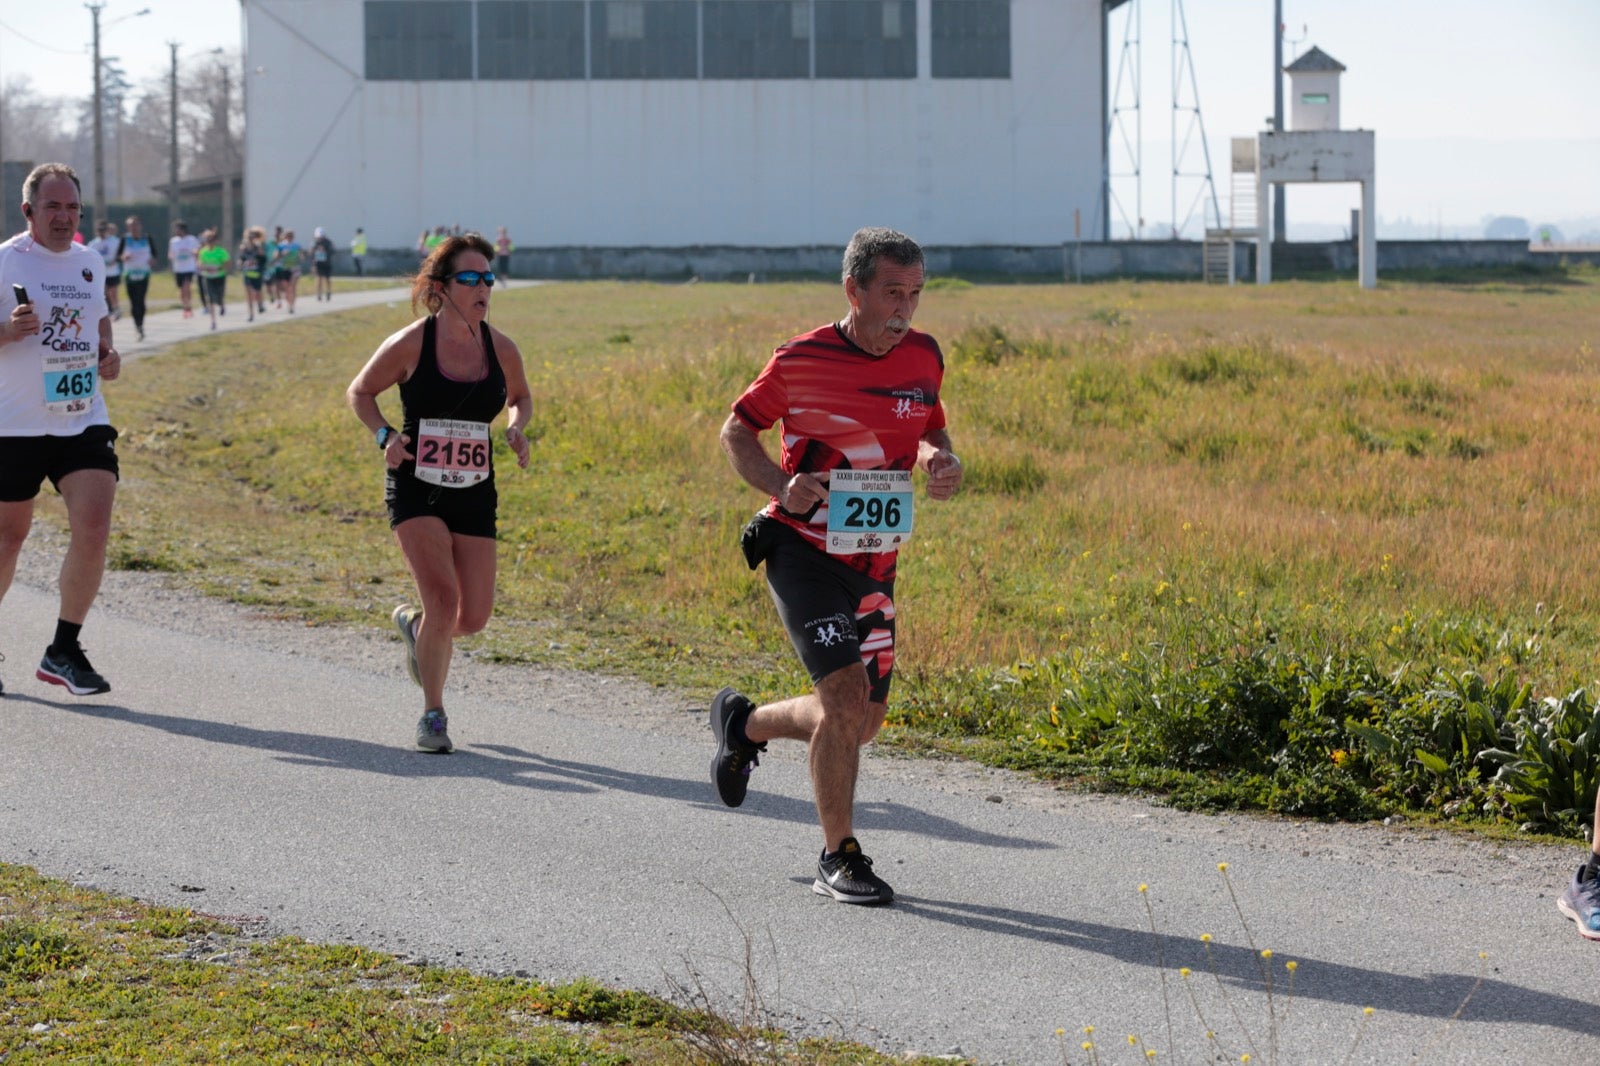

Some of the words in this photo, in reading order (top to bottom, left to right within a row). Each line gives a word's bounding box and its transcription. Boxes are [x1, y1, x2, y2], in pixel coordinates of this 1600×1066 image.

[41, 283, 76, 291] fuerzas
[51, 291, 91, 299] armadas
[42, 326, 54, 345] 2
[56, 371, 92, 396] 463
[422, 440, 486, 468] 2156
[854, 472, 869, 480] GRAN
[870, 473, 888, 481] PREMIO
[889, 473, 895, 481] DE
[844, 497, 901, 528] 296
